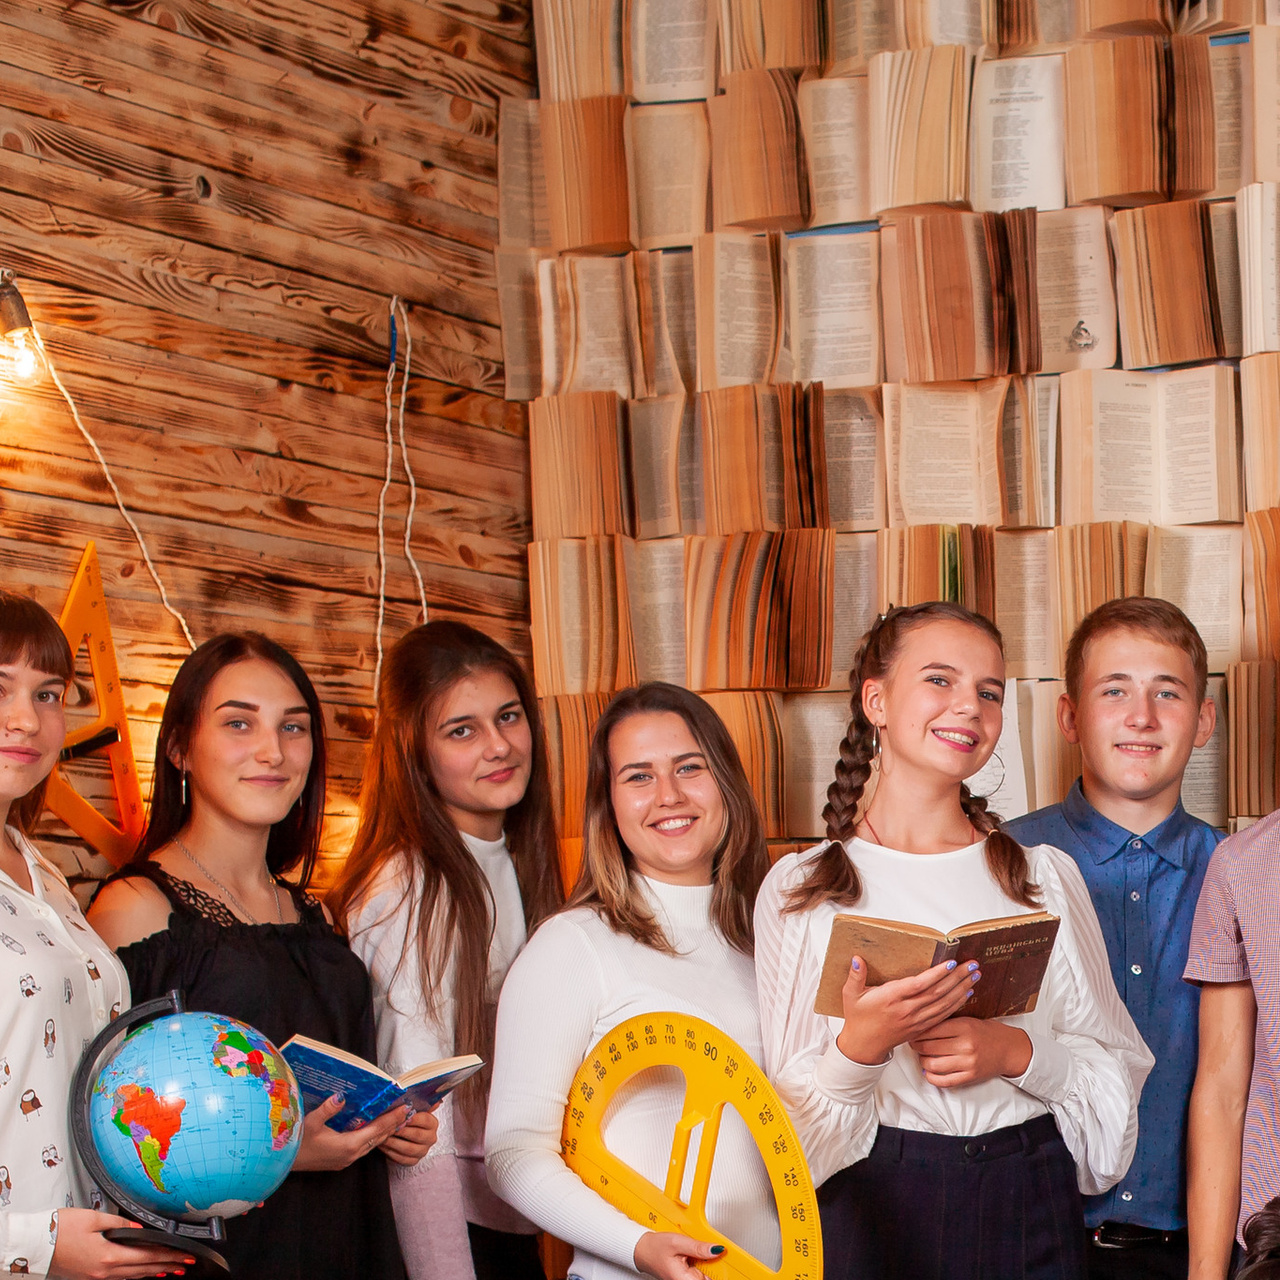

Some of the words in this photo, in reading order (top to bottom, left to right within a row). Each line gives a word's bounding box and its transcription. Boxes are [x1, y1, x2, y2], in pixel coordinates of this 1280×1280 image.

[98, 640, 106, 652] 10
[107, 682, 114, 694] 15
[644, 1025, 653, 1034] 60
[665, 1024, 674, 1034] 70
[686, 1029, 695, 1039] 80
[626, 1031, 634, 1042] 50
[645, 1035, 657, 1045] 120
[664, 1035, 676, 1045] 110
[608, 1043, 617, 1054] 40
[627, 1040, 639, 1052] 130
[684, 1040, 696, 1051] 100
[703, 1042, 718, 1061] 90
[610, 1051, 622, 1064] 140
[726, 1055, 739, 1071] 100
[593, 1060, 602, 1073] 30
[724, 1066, 734, 1078] 80
[596, 1066, 607, 1081] 150
[580, 1082, 588, 1095] 20
[745, 1077, 757, 1094] 110
[584, 1087, 595, 1103] 160
[742, 1086, 752, 1100] 70
[571, 1108, 579, 1119] 10
[576, 1111, 585, 1128] 170
[758, 1112, 767, 1125] 60
[762, 1104, 774, 1122] 120
[570, 1138, 578, 1155] 180
[772, 1141, 781, 1155] 50
[777, 1134, 788, 1153] 130
[600, 1175, 609, 1186] 40
[784, 1172, 792, 1186] 40
[788, 1167, 799, 1187] 140
[648, 1212, 658, 1224] 30
[790, 1205, 798, 1219] 30
[798, 1202, 806, 1222] 150
[794, 1239, 801, 1253] 20
[801, 1238, 809, 1257] 160
